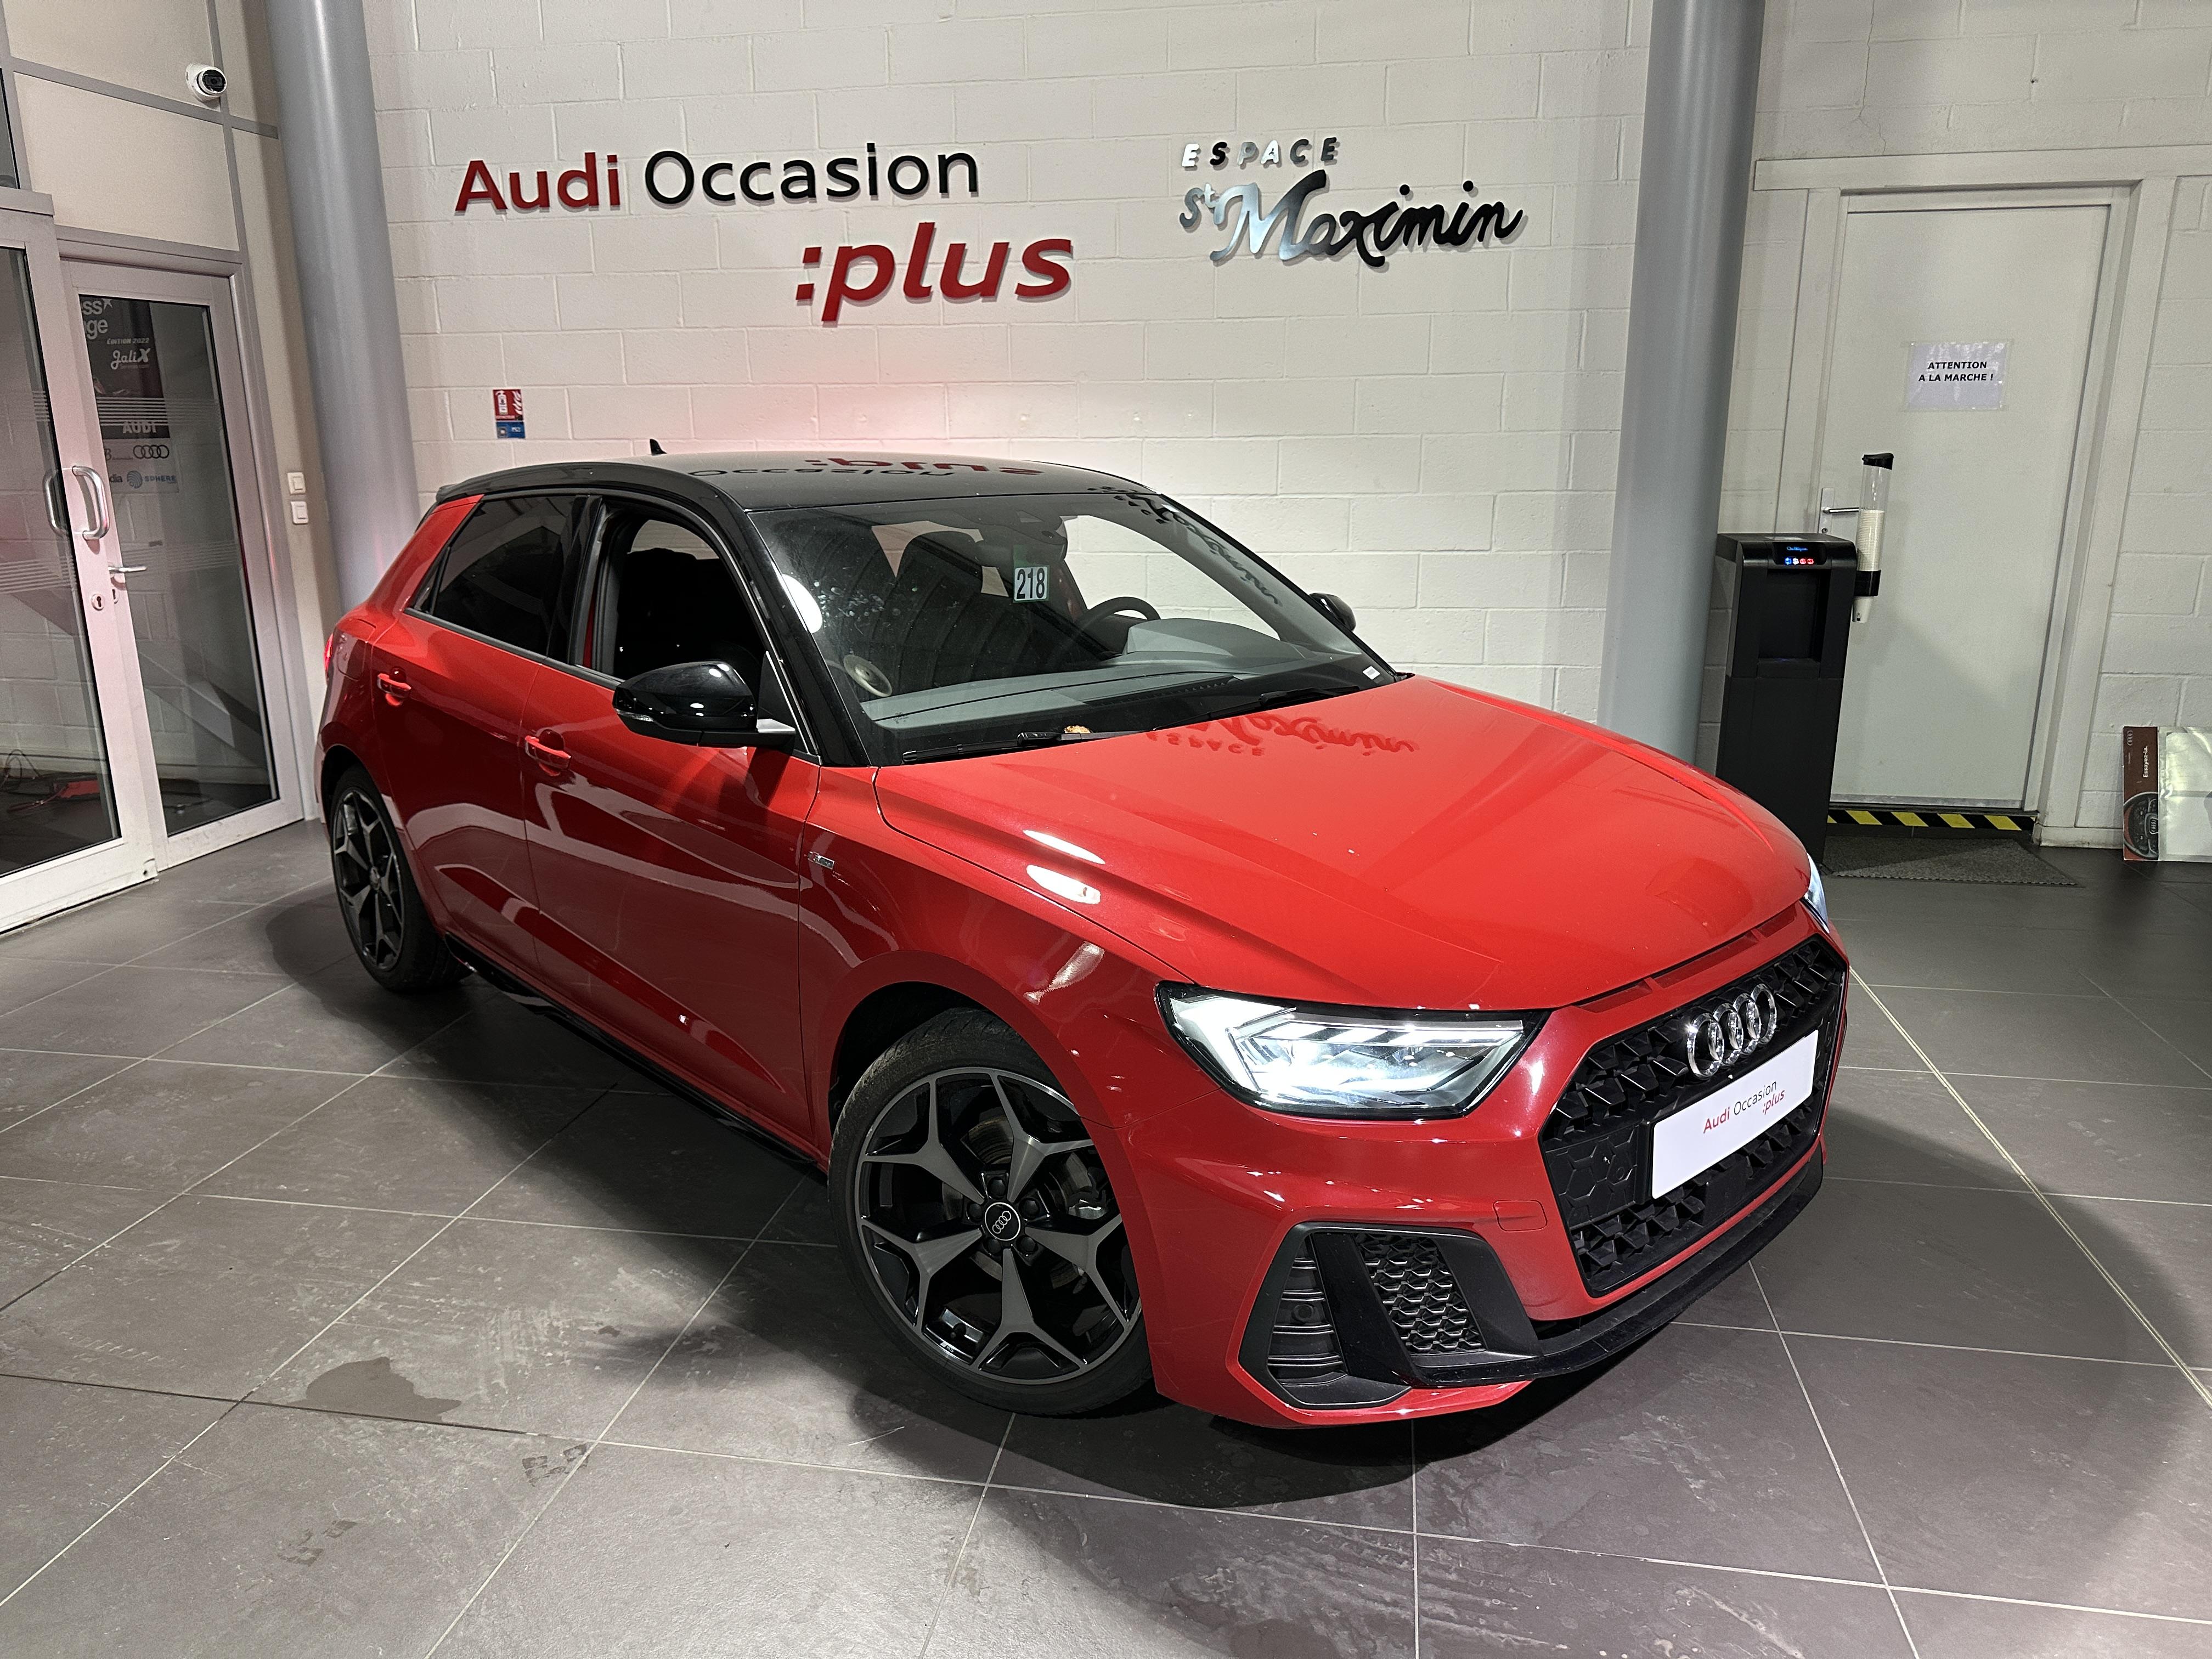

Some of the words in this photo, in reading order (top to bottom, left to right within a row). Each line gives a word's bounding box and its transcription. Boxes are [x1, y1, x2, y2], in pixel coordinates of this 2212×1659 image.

[1181, 137, 1339, 168] ESPACE
[455, 152, 621, 213] Audi
[645, 143, 979, 205] Occasion
[1180, 183, 1219, 228] St
[1209, 169, 1523, 268] Maximin
[795, 222, 1073, 323] :plus
[84, 319, 109, 340] ge
[1918, 374, 1926, 382] A
[1929, 374, 1941, 382] LA
[1944, 373, 1988, 382] MARCHE
[1928, 361, 1987, 369] ATTENTION
[1016, 567, 1046, 600] 218
[1703, 1107, 1730, 1134] Audi
[1734, 1081, 1777, 1115] Occasion
[1762, 1090, 1785, 1115] :plus
